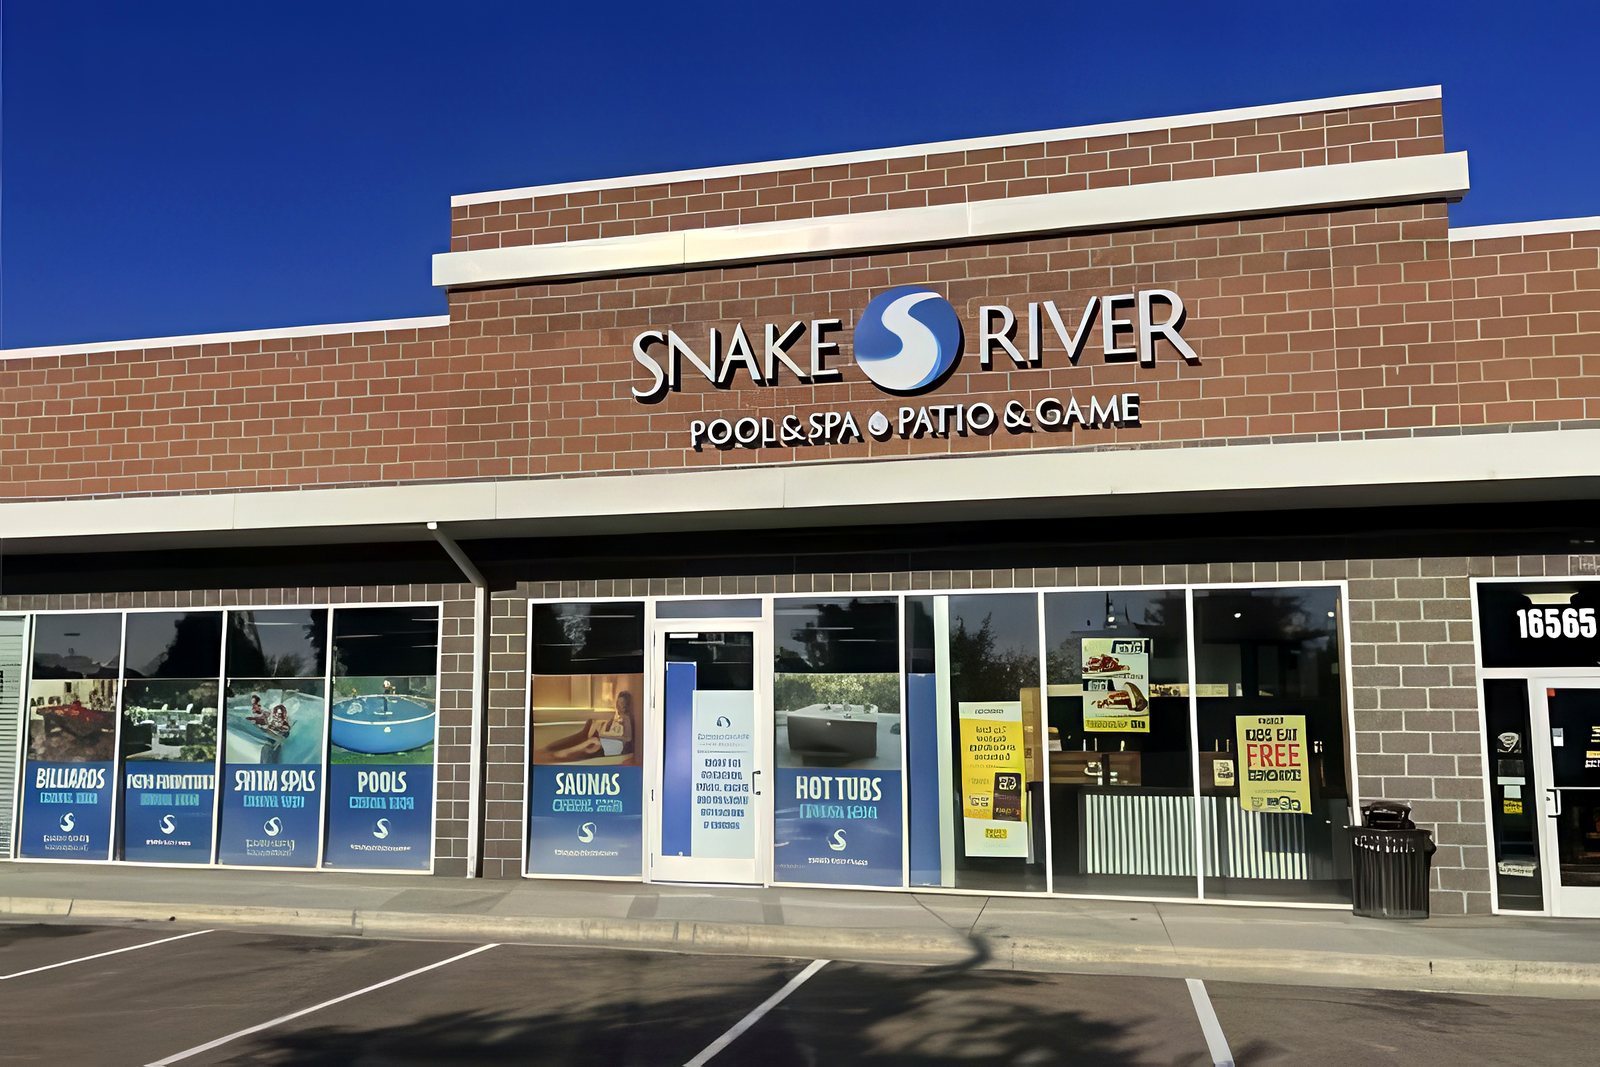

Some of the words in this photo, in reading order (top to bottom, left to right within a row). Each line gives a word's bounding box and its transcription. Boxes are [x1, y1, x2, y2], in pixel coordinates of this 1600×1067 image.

[631, 318, 842, 398] SNAKE
[979, 288, 1199, 364] RIVER
[690, 416, 776, 449] POOL
[808, 410, 860, 440] SPA
[898, 403, 995, 434] PATIO
[1003, 399, 1032, 428] &
[1035, 392, 1140, 426] GAME
[1516, 607, 1597, 639] 16565
[1246, 743, 1301, 767] FREE
[357, 770, 408, 793] POOLS
[555, 772, 620, 796] SAUNAS
[796, 775, 833, 800] HOT
[834, 776, 882, 802] TUBS
